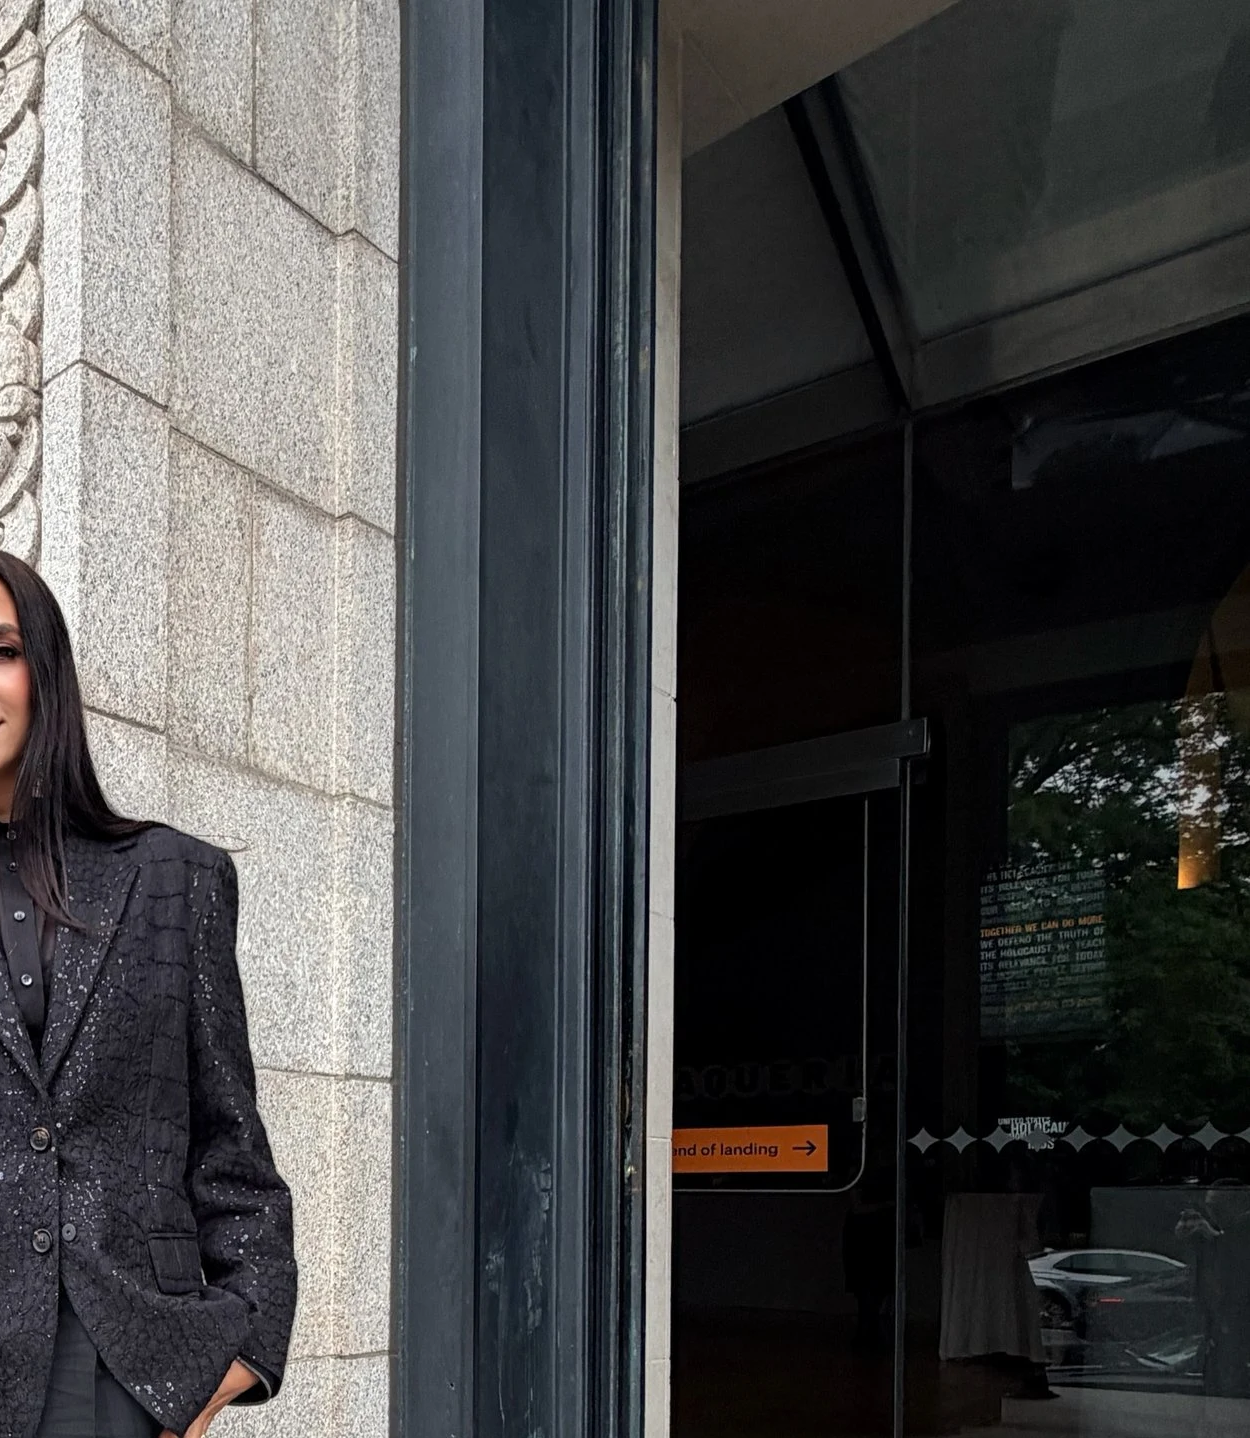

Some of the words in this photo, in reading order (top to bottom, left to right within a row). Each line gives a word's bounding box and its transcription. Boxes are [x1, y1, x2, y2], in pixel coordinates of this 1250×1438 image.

[1024, 922, 1038, 933] WE
[1041, 920, 1059, 930] CAN
[1062, 918, 1074, 928] DO
[980, 939, 994, 949] WE
[998, 935, 1031, 947] DEFEND
[1036, 932, 1053, 943] THE
[1059, 928, 1088, 940] TRUTH
[1093, 926, 1105, 936] OF
[980, 950, 996, 961] THE
[700, 1143, 717, 1156] of
[720, 1142, 779, 1158] landing
